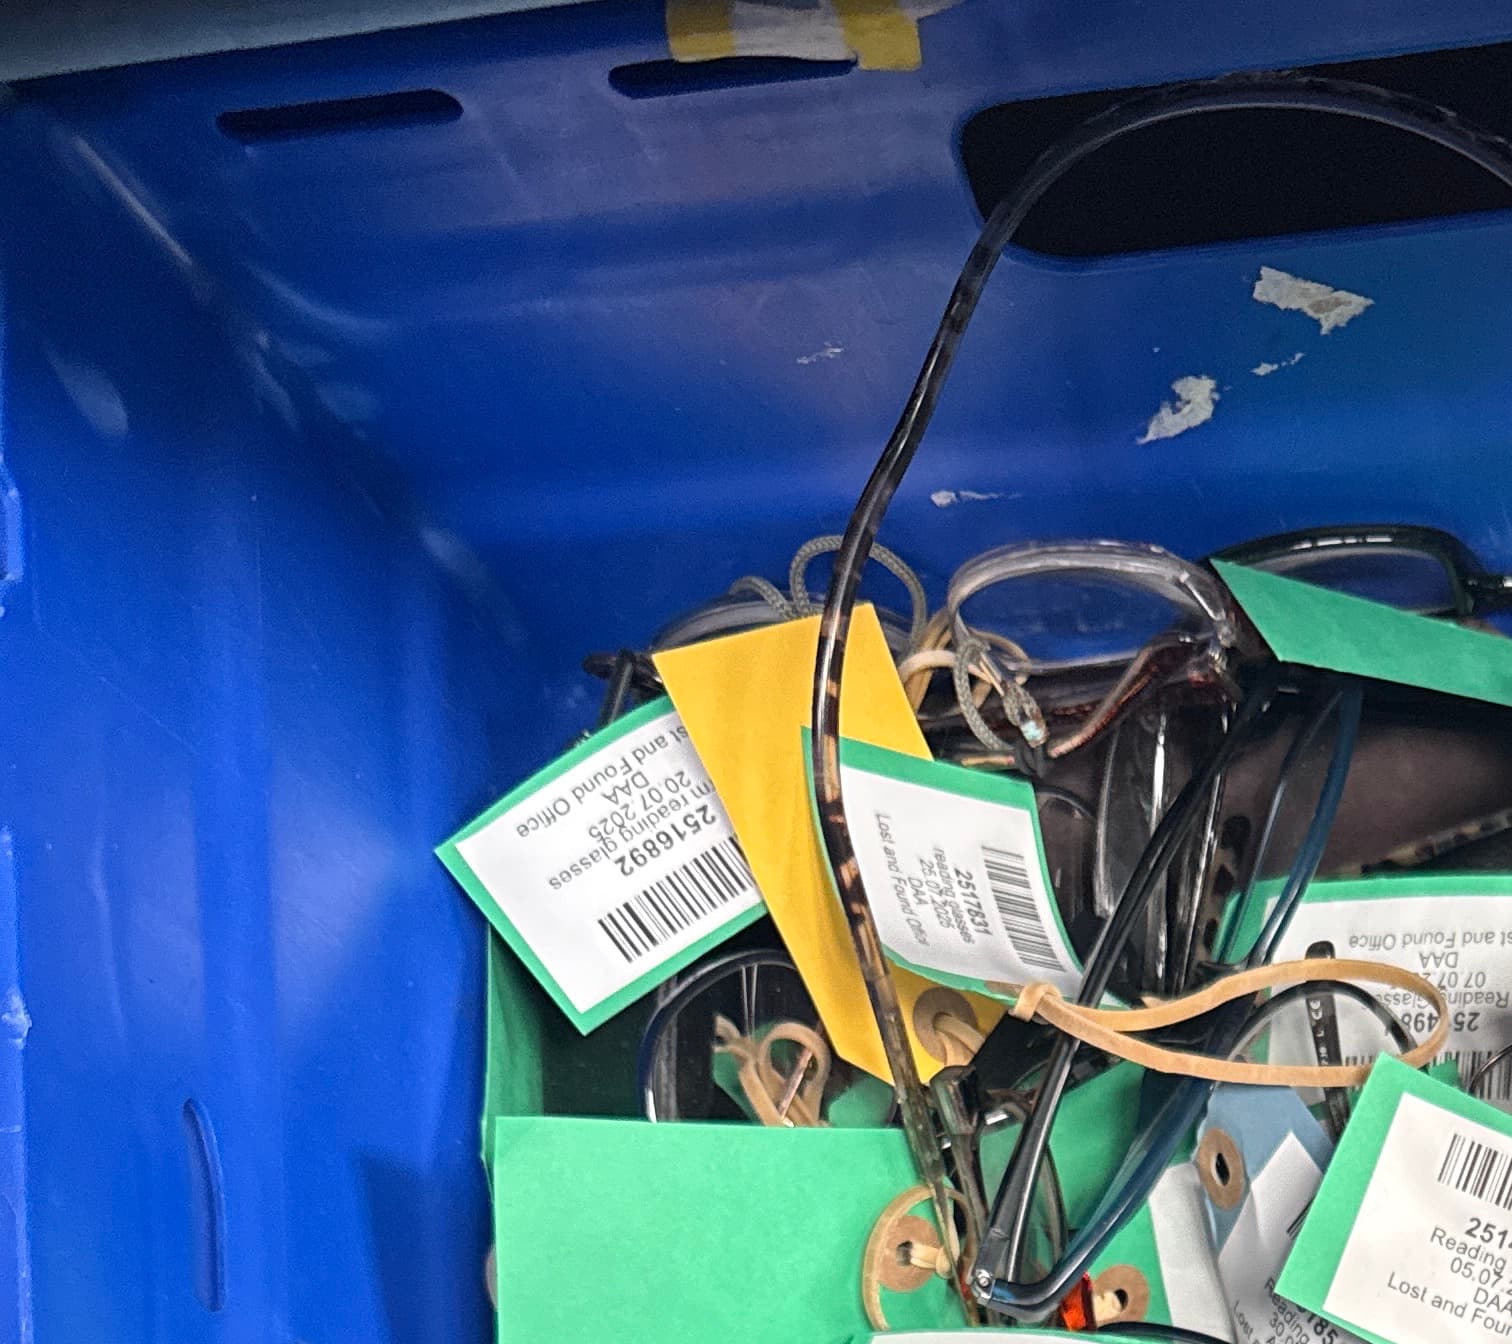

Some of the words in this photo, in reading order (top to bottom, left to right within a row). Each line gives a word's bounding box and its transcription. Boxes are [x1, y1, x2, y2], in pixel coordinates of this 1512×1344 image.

[631, 734, 668, 765] and
[668, 722, 689, 743] st
[571, 756, 632, 804] Found
[601, 770, 650, 805] DAA
[516, 797, 570, 837] Office
[588, 769, 691, 842] 20.07.2025
[617, 793, 689, 842] reading
[613, 804, 716, 876] 2516892
[874, 815, 893, 842] Lost
[548, 831, 617, 889] glasses
[882, 845, 900, 871] and
[891, 877, 917, 914] Found
[906, 877, 929, 905] DAA
[918, 859, 955, 929] 25.07.2025
[932, 848, 955, 895] reading
[945, 900, 975, 943] glasses
[953, 869, 992, 935] 2517831
[1348, 933, 1396, 950] Office
[1402, 931, 1456, 948] Found
[1462, 931, 1495, 947] and
[1418, 951, 1458, 968] DAA
[1429, 1226, 1507, 1277] Reading
[1387, 1271, 1427, 1302] Lost
[1430, 1295, 1467, 1318] and
[1472, 1287, 1512, 1317] DAA
[1229, 1299, 1254, 1340] Lost
